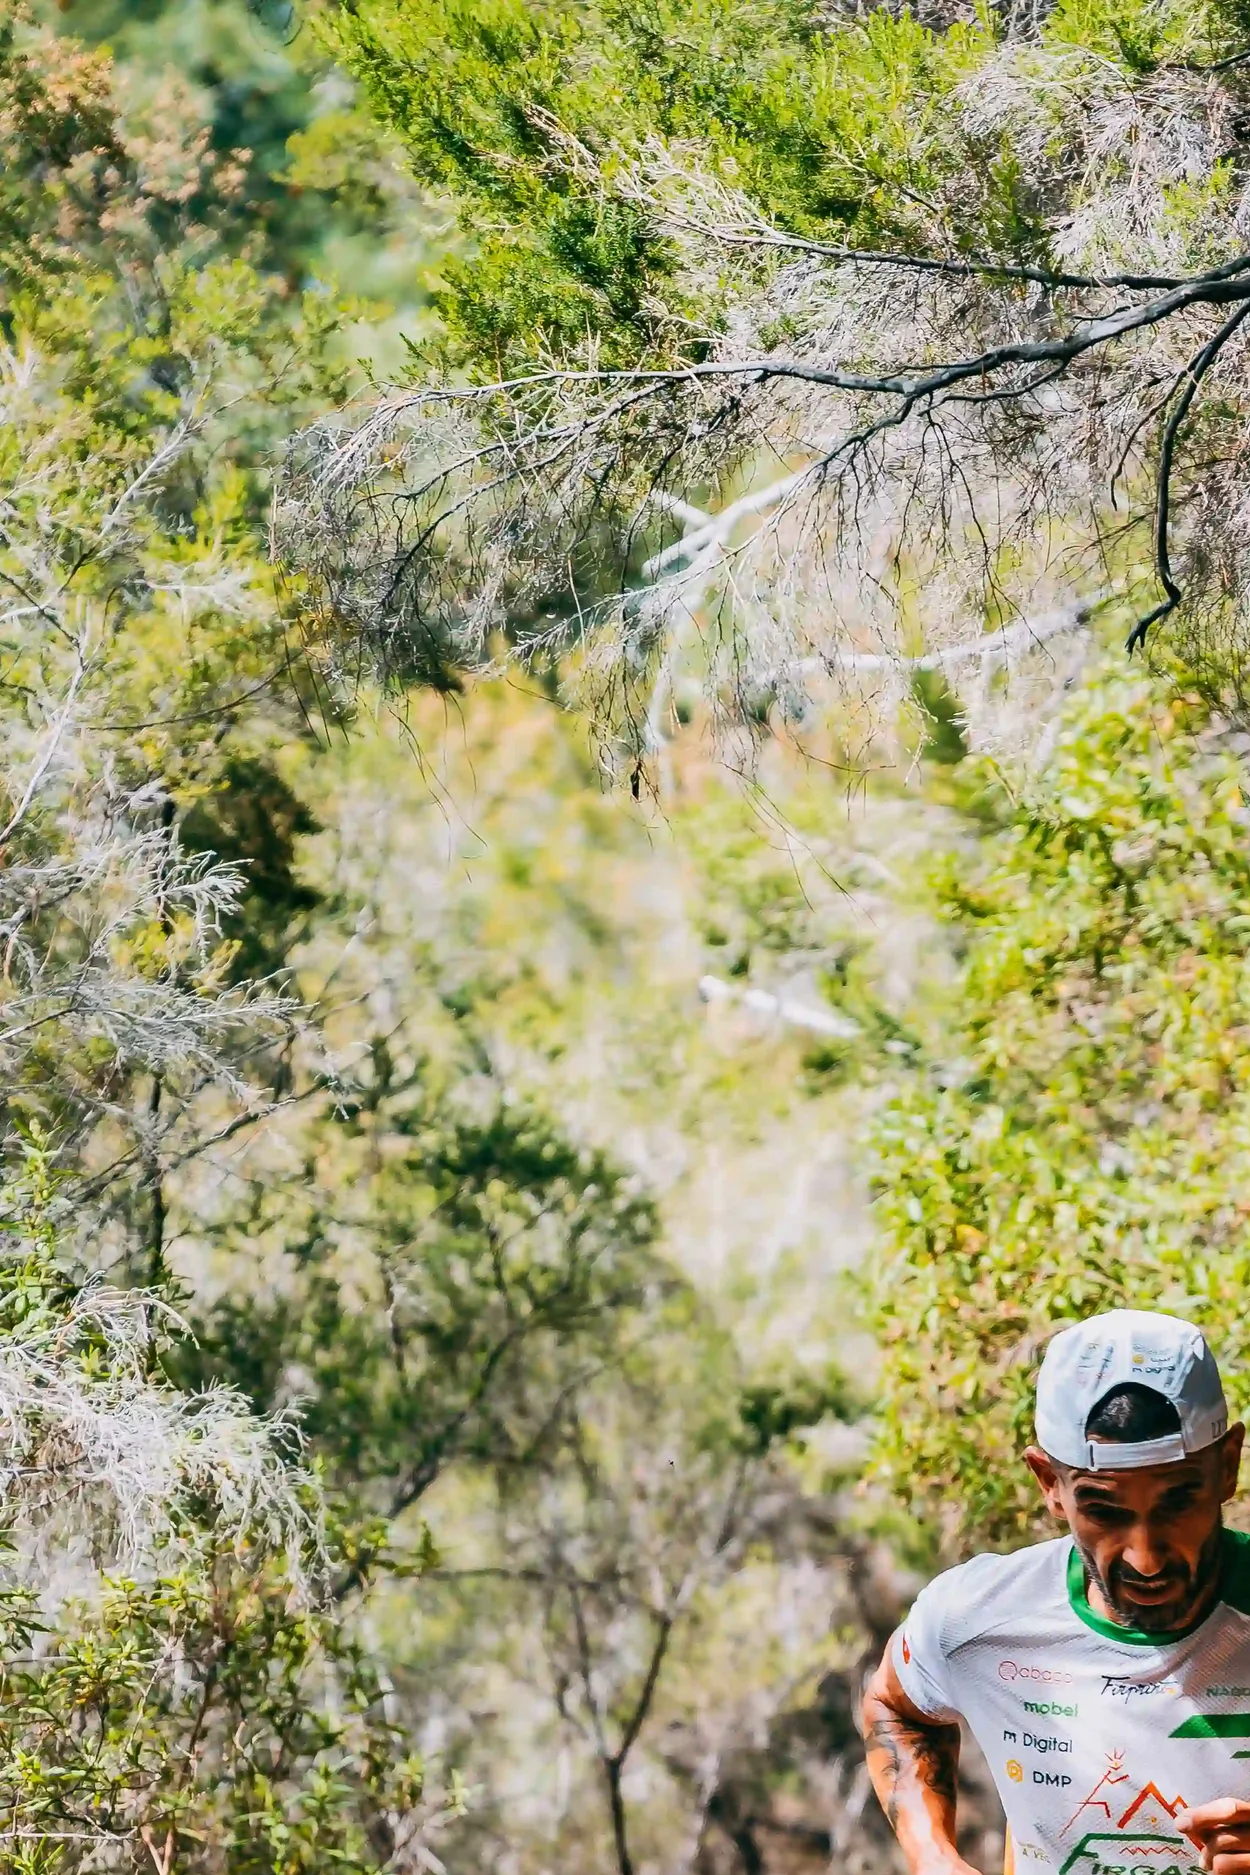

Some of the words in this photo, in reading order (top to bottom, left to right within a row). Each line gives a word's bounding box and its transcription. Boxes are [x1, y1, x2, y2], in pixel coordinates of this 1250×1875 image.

[1023, 1700, 1078, 1718] mobel
[1022, 1732, 1073, 1753] Digital
[1032, 1770, 1073, 1788] DMP
